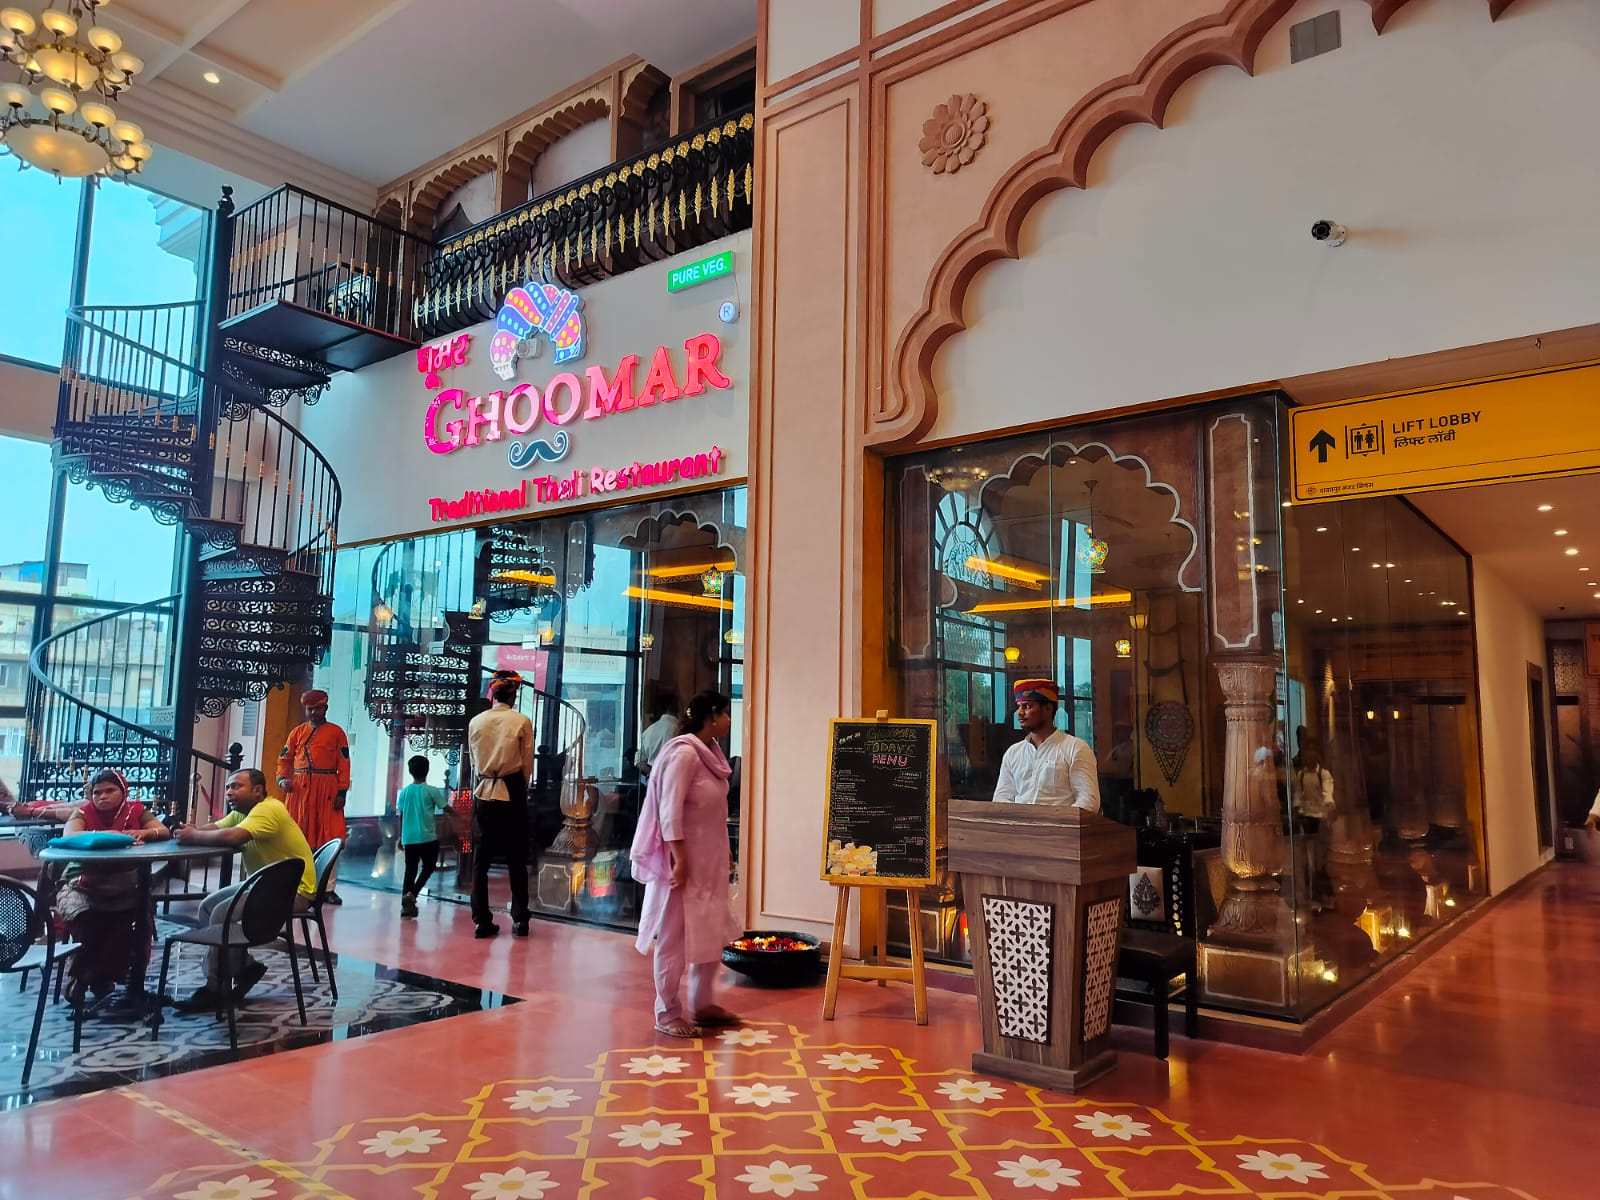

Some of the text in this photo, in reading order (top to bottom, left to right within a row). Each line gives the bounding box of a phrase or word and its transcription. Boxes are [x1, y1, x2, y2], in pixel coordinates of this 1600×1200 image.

[672, 257, 727, 287] PURE VEG.
[424, 333, 731, 455] GHOOMAR
[1392, 410, 1481, 434] LIFT LOBBY
[1393, 429, 1456, 448] लिफ्ट लॉबी
[428, 445, 722, 522] Traditional Thali Restaurant
[872, 754, 908, 767] MENU
